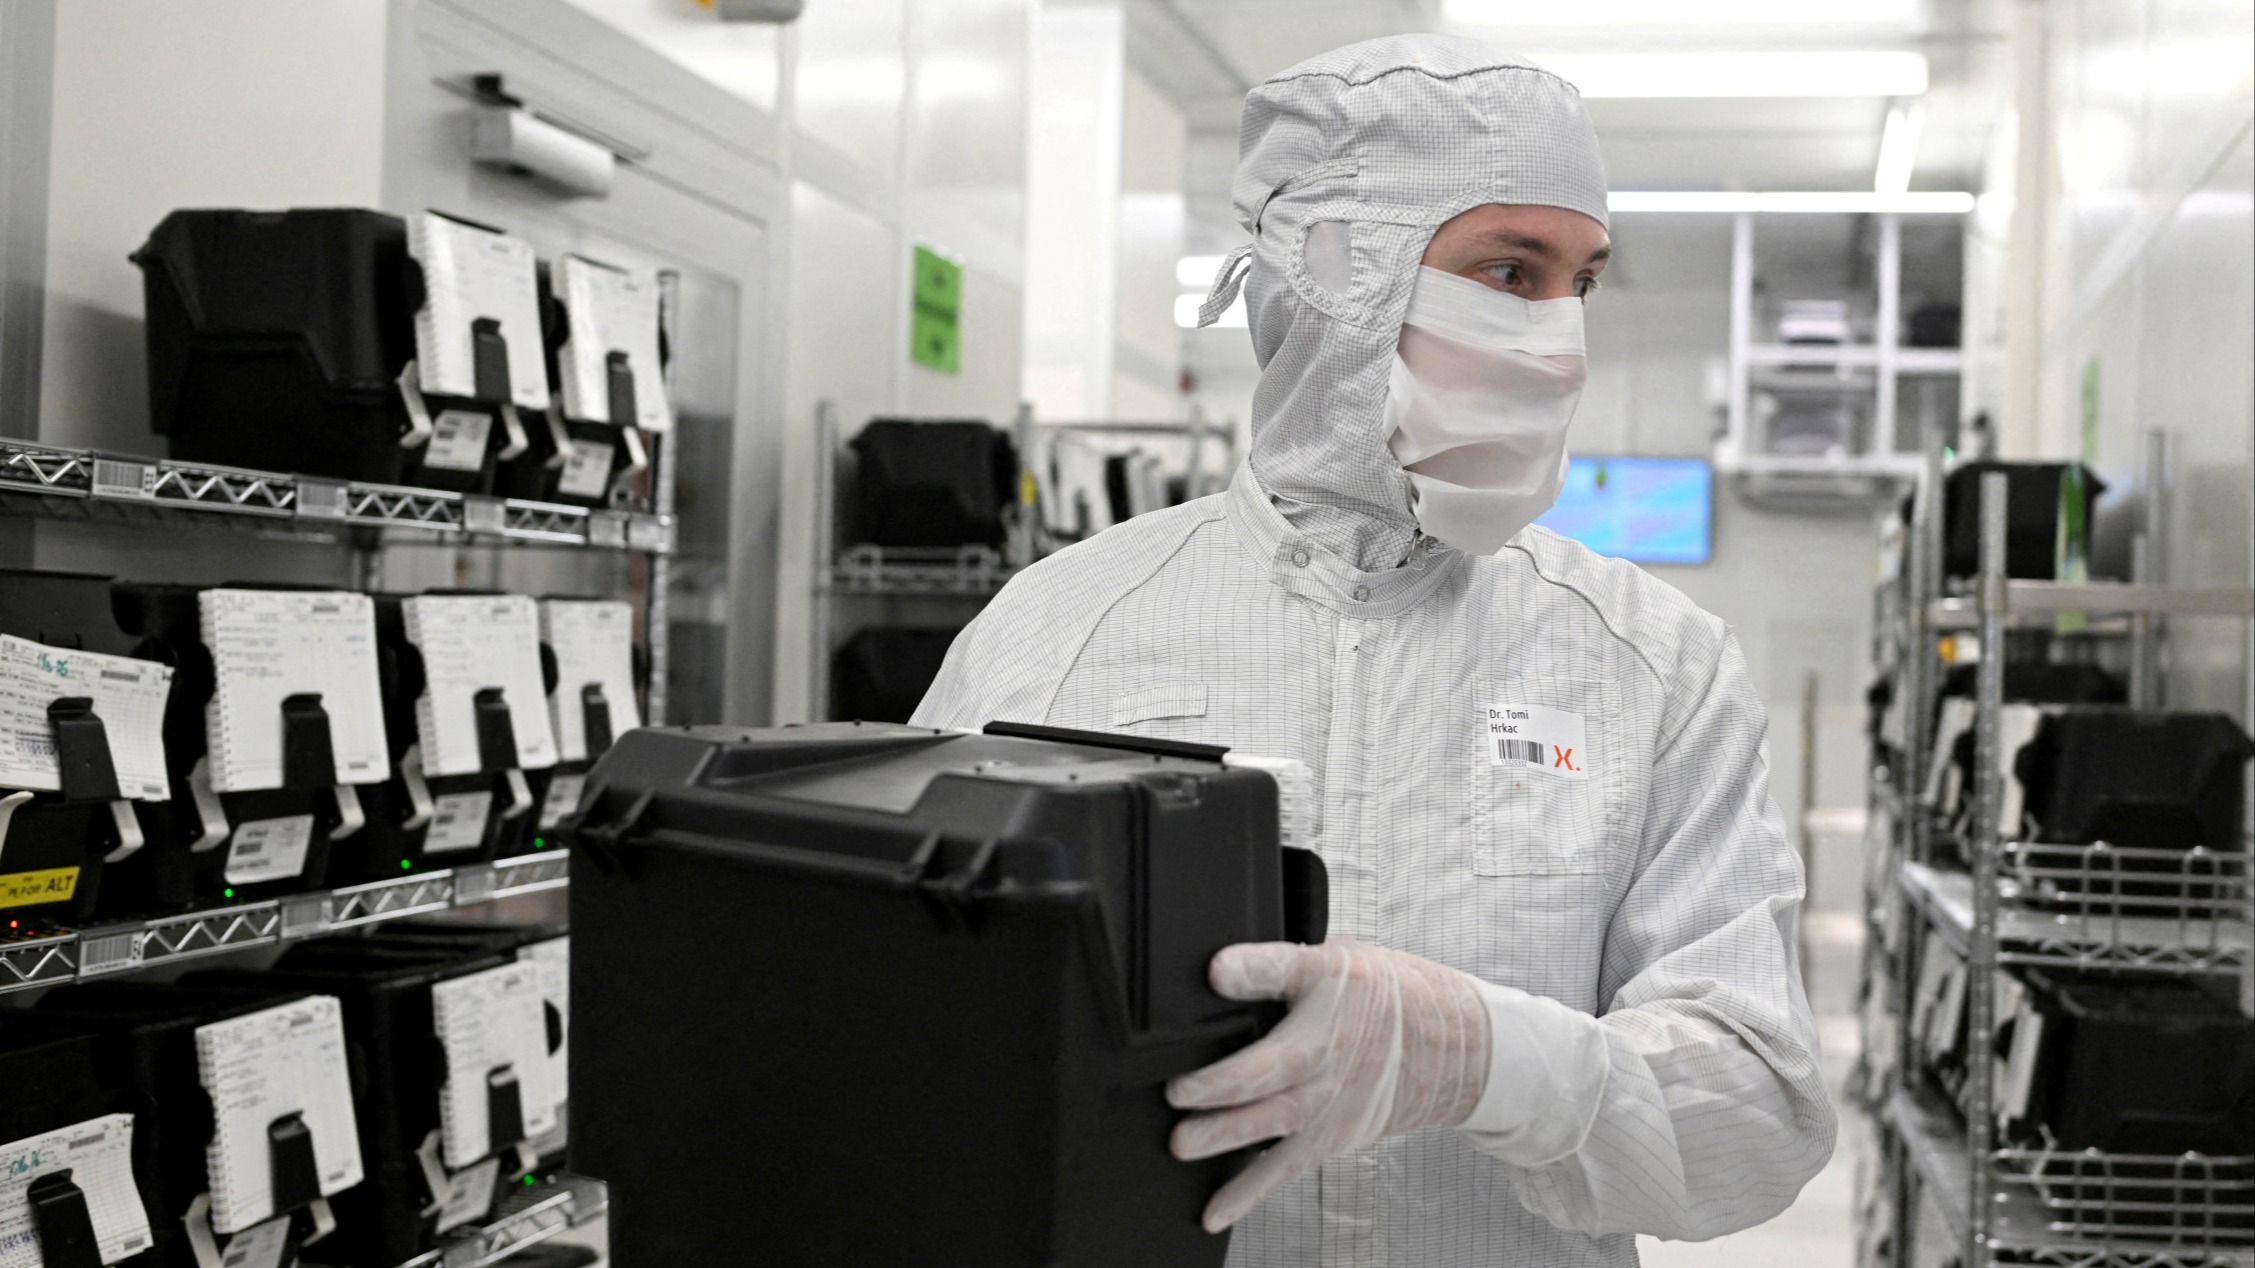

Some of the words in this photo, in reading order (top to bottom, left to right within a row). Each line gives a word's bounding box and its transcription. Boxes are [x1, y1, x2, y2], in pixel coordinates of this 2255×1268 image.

[1489, 709, 1504, 719] Dr.
[1505, 709, 1529, 720] Tomi
[1490, 723, 1518, 734] Hrkac
[45, 875, 73, 892] ALT
